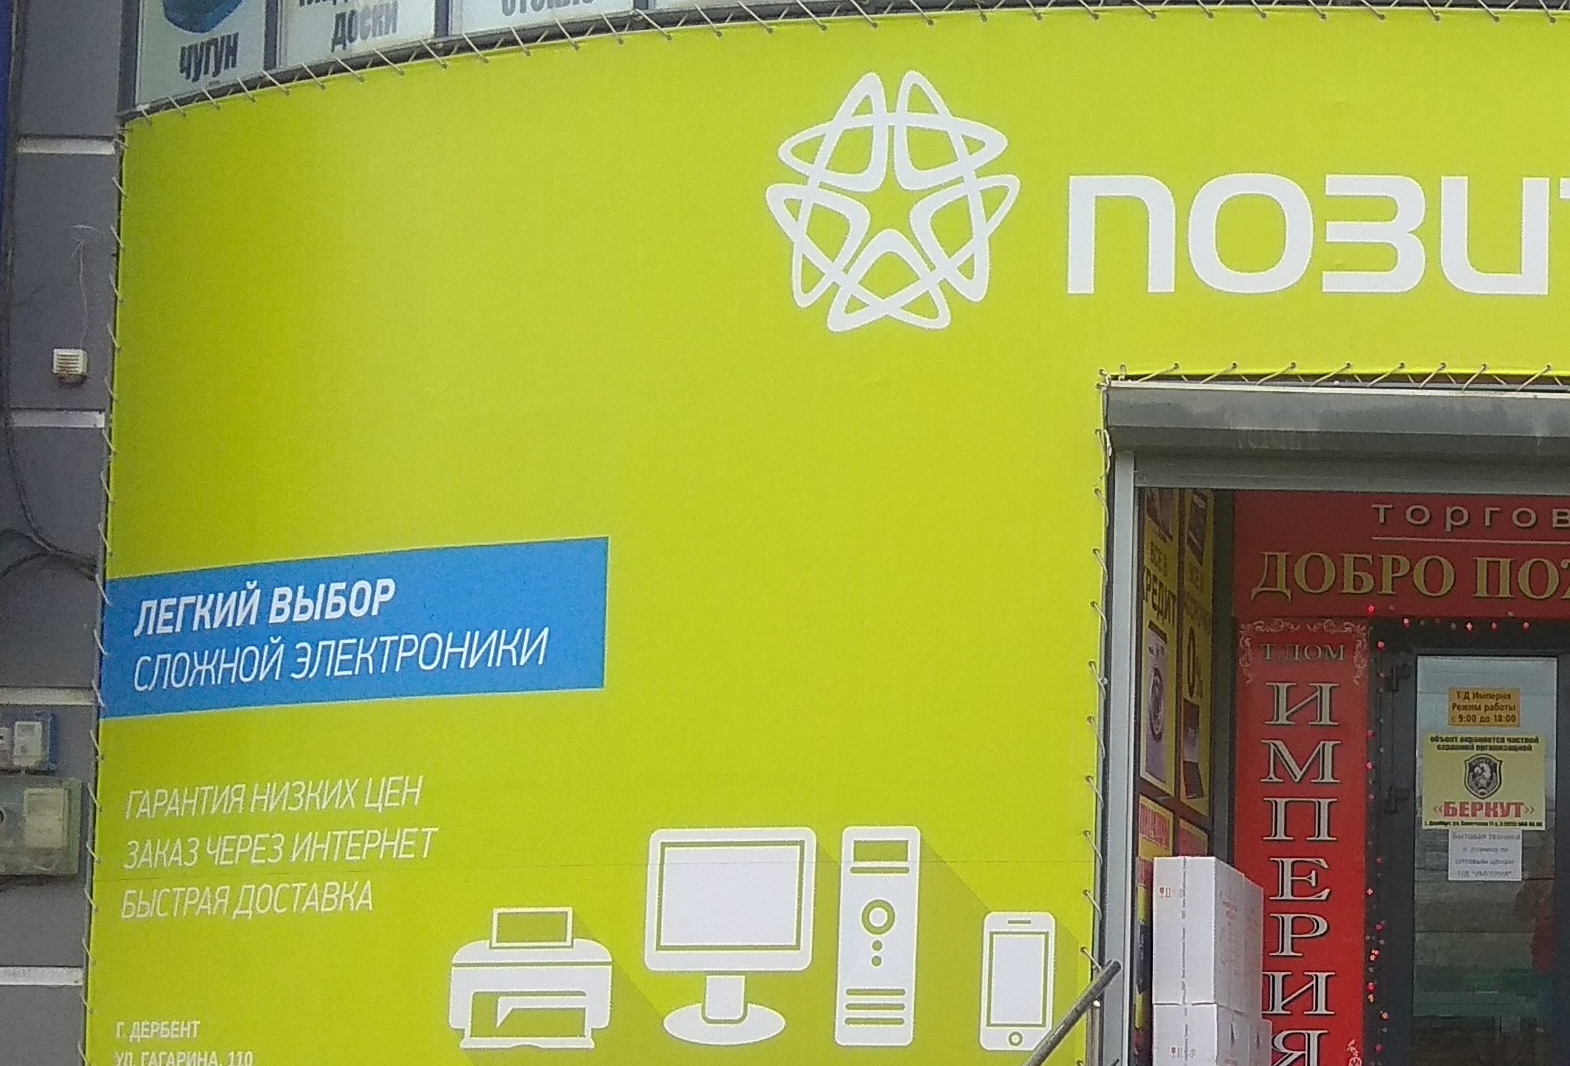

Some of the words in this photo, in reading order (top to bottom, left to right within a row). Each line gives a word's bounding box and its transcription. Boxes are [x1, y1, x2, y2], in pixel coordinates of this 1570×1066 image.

[331, 1, 398, 52] доски
[178, 32, 239, 83] чугун
[1250, 551, 1454, 601] ДОБРО
[133, 583, 260, 637] ЛЕГКИЙ
[269, 578, 396, 624] ВЫБОР
[134, 638, 284, 692] СЛОЖНОЙ
[291, 627, 550, 680] ЭЛЕКТРОНИКИ
[1451, 702, 1481, 712] Режим
[1483, 702, 1516, 713] работы
[1458, 714, 1477, 723] 9:00
[1493, 714, 1516, 723] 18:00
[125, 783, 246, 820] ГАРАНТИЯ
[251, 778, 360, 815] НИЗКИХ
[364, 776, 424, 812] ЦЕН
[123, 837, 199, 869] ЗАКАЗ
[206, 833, 284, 866] ЧЕРЕЗ
[289, 827, 438, 862] ИНТЕРНЕТ
[121, 884, 229, 919] БЫСТРАЯ
[233, 881, 373, 919] ДОСТАВКА
[115, 1021, 125, 1039] Г.
[129, 1020, 201, 1042] ДЕРБЕНТ
